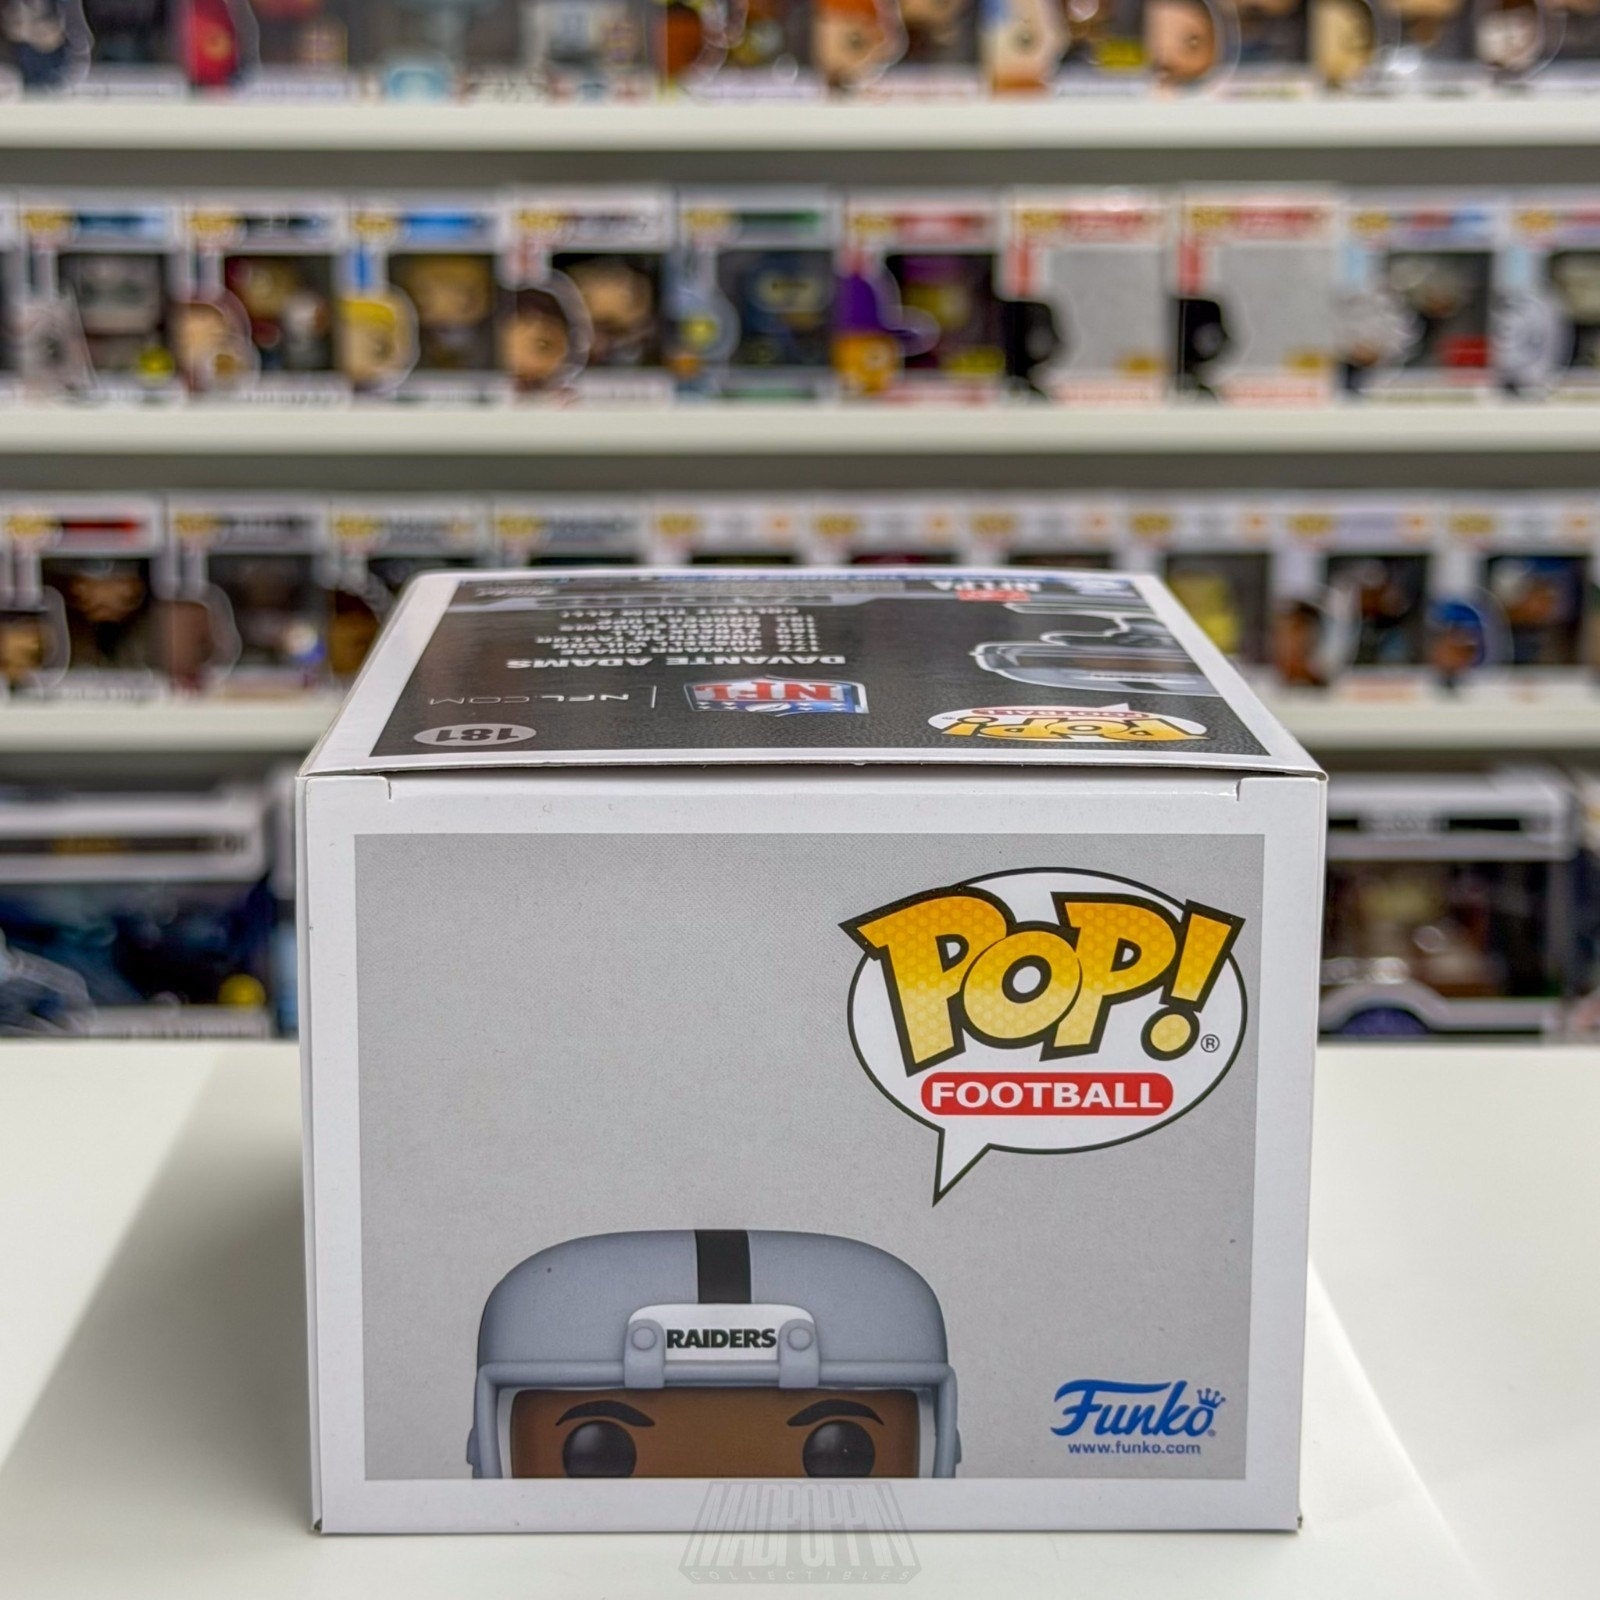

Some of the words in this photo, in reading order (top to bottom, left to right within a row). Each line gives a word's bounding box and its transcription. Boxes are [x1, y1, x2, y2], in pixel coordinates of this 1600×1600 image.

[506, 657, 653, 668] ADAMS
[665, 655, 846, 665] DAVANTE
[694, 680, 840, 702] NFL
[435, 728, 520, 743] 181
[940, 716, 1211, 741] POP!
[838, 885, 1246, 1077] POP!
[931, 1080, 1164, 1109] FOOTBALL
[666, 1327, 778, 1349] RAIDERS
[1050, 1379, 1215, 1437] Funko
[1067, 1440, 1202, 1455] www.funko.com
